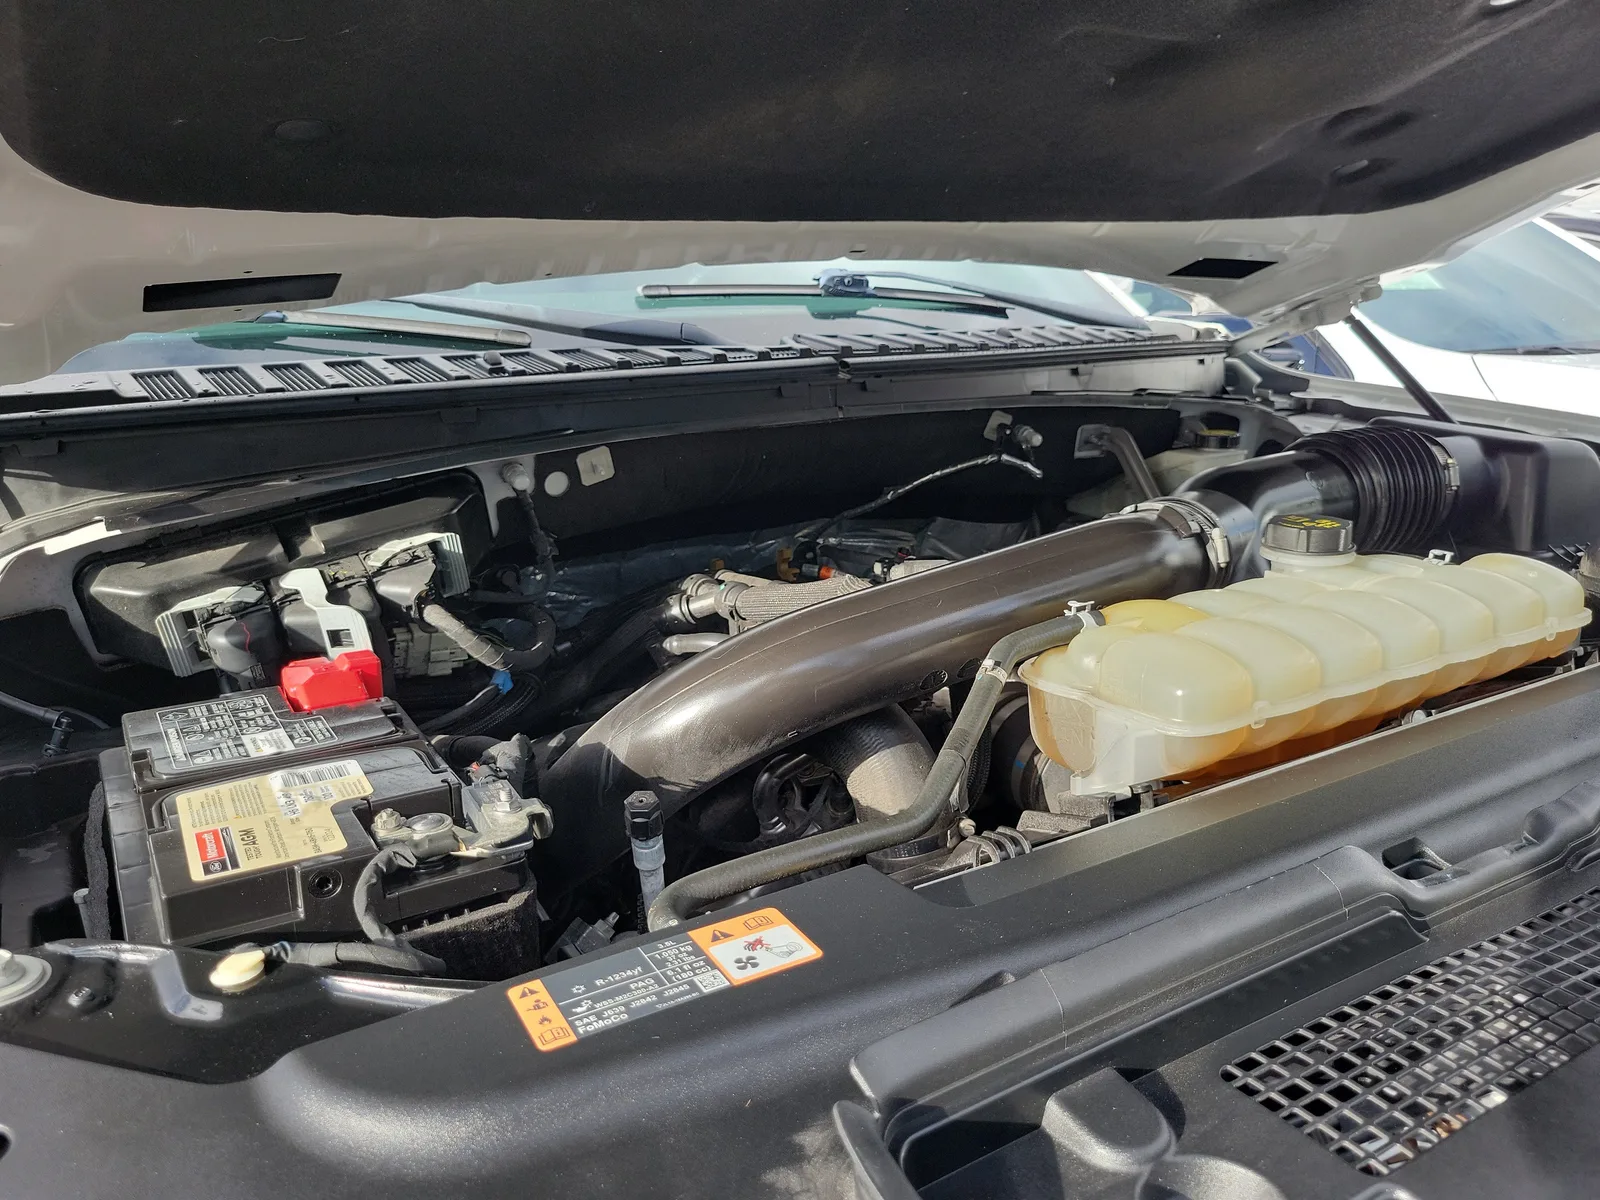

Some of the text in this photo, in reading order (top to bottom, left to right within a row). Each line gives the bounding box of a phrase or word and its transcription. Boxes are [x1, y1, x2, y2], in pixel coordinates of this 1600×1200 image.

[238, 827, 259, 846] AGM
[202, 831, 220, 860] Motorcraft
[657, 940, 677, 949] 3.5L
[655, 948, 679, 960] 1.050
[666, 954, 676, 962] 37
[665, 958, 682, 967] 2.31
[682, 963, 692, 971] fl
[595, 966, 643, 986] R-1234yf
[672, 965, 712, 982] (180 cc)
[629, 977, 655, 990] PAG
[574, 1014, 598, 1026] SAE
[602, 1005, 626, 1017] J639
[629, 994, 658, 1008] J2842
[663, 983, 691, 997] J2845
[577, 1013, 629, 1034] FoMoCo
